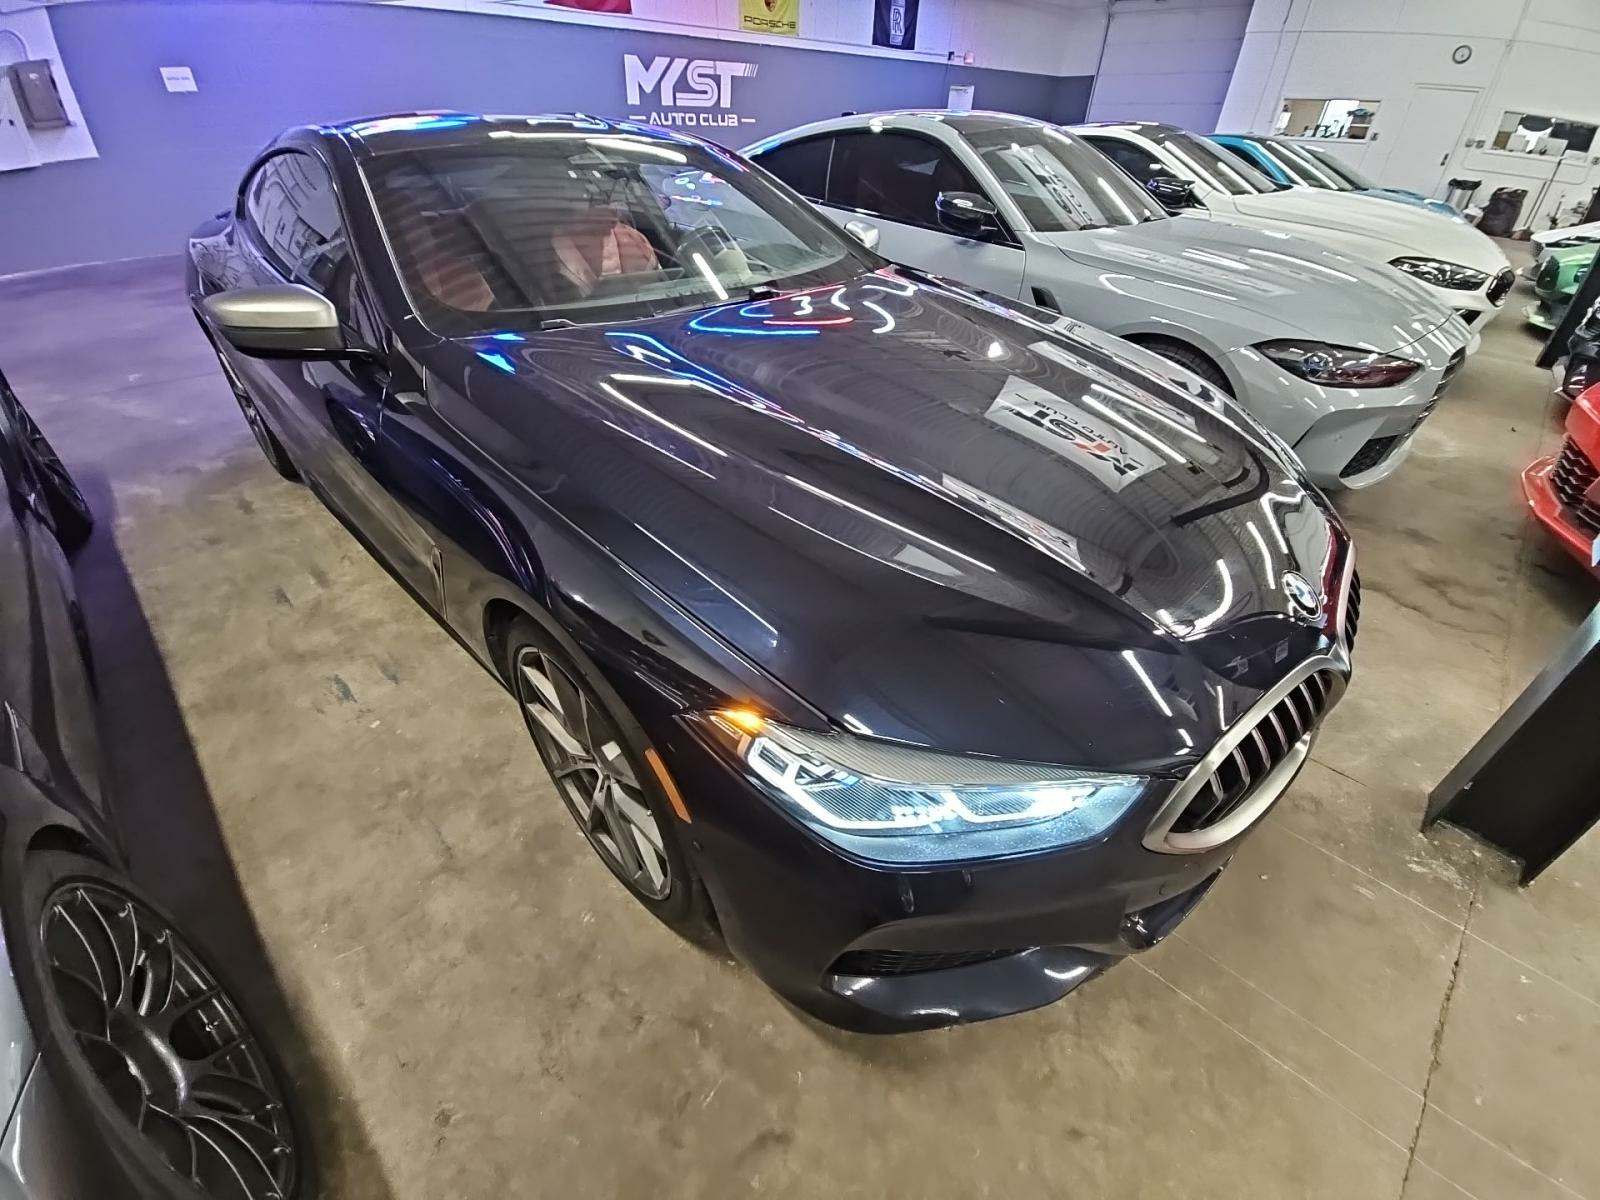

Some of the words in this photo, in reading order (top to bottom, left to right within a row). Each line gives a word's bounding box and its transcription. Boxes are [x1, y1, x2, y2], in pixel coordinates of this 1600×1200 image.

[744, 15, 796, 29] PORSCHE
[624, 54, 758, 108] MYST
[649, 112, 697, 126] AUTO
[699, 113, 738, 127] CLUB
[1034, 400, 1079, 425] CLUB
[1081, 426, 1128, 455] AUTO
